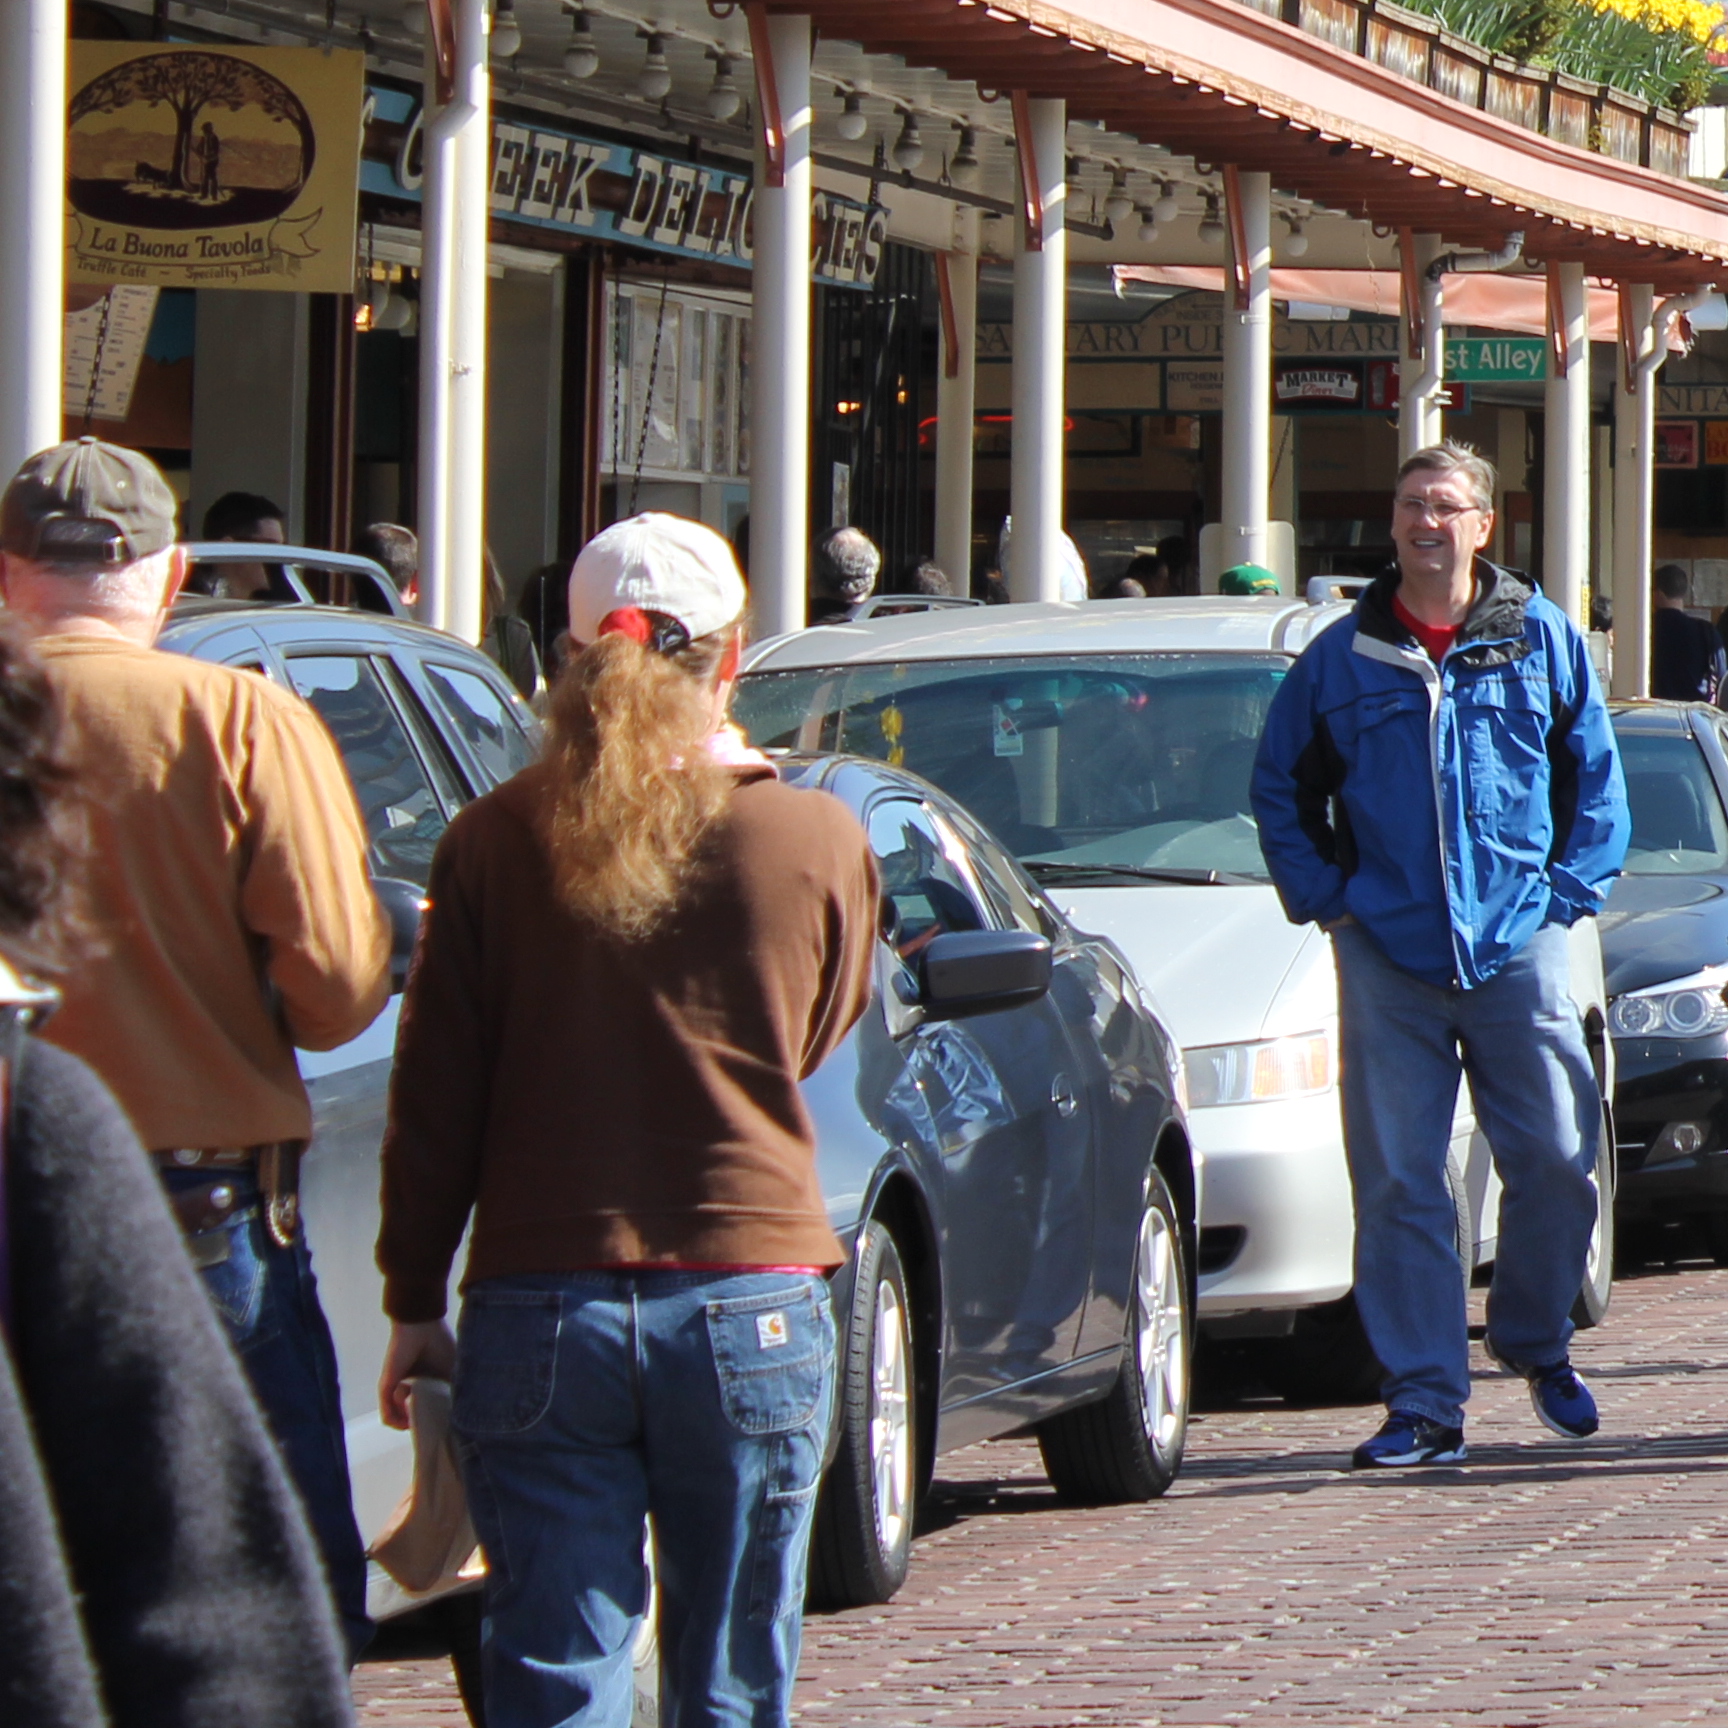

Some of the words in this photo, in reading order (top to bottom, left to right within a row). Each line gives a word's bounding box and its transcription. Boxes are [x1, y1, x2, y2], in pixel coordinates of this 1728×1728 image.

[401, 108, 612, 226] EEK
[619, 153, 888, 284] DELIIES
[89, 227, 117, 252] La
[122, 232, 189, 258] Buona
[195, 232, 263, 258] Tavola
[77, 255, 118, 277] Truffle
[120, 262, 148, 278] Café
[185, 265, 239, 284] Specialty
[241, 262, 272, 277] Foods
[975, 325, 1149, 353] SAARY
[1161, 325, 1293, 353] PUC
[1444, 345, 1468, 370] st
[1478, 343, 1542, 375] Alley
[1168, 371, 1217, 383] KITCHEN
[1285, 371, 1348, 389] MARKET
[1302, 384, 1333, 396] Diner
